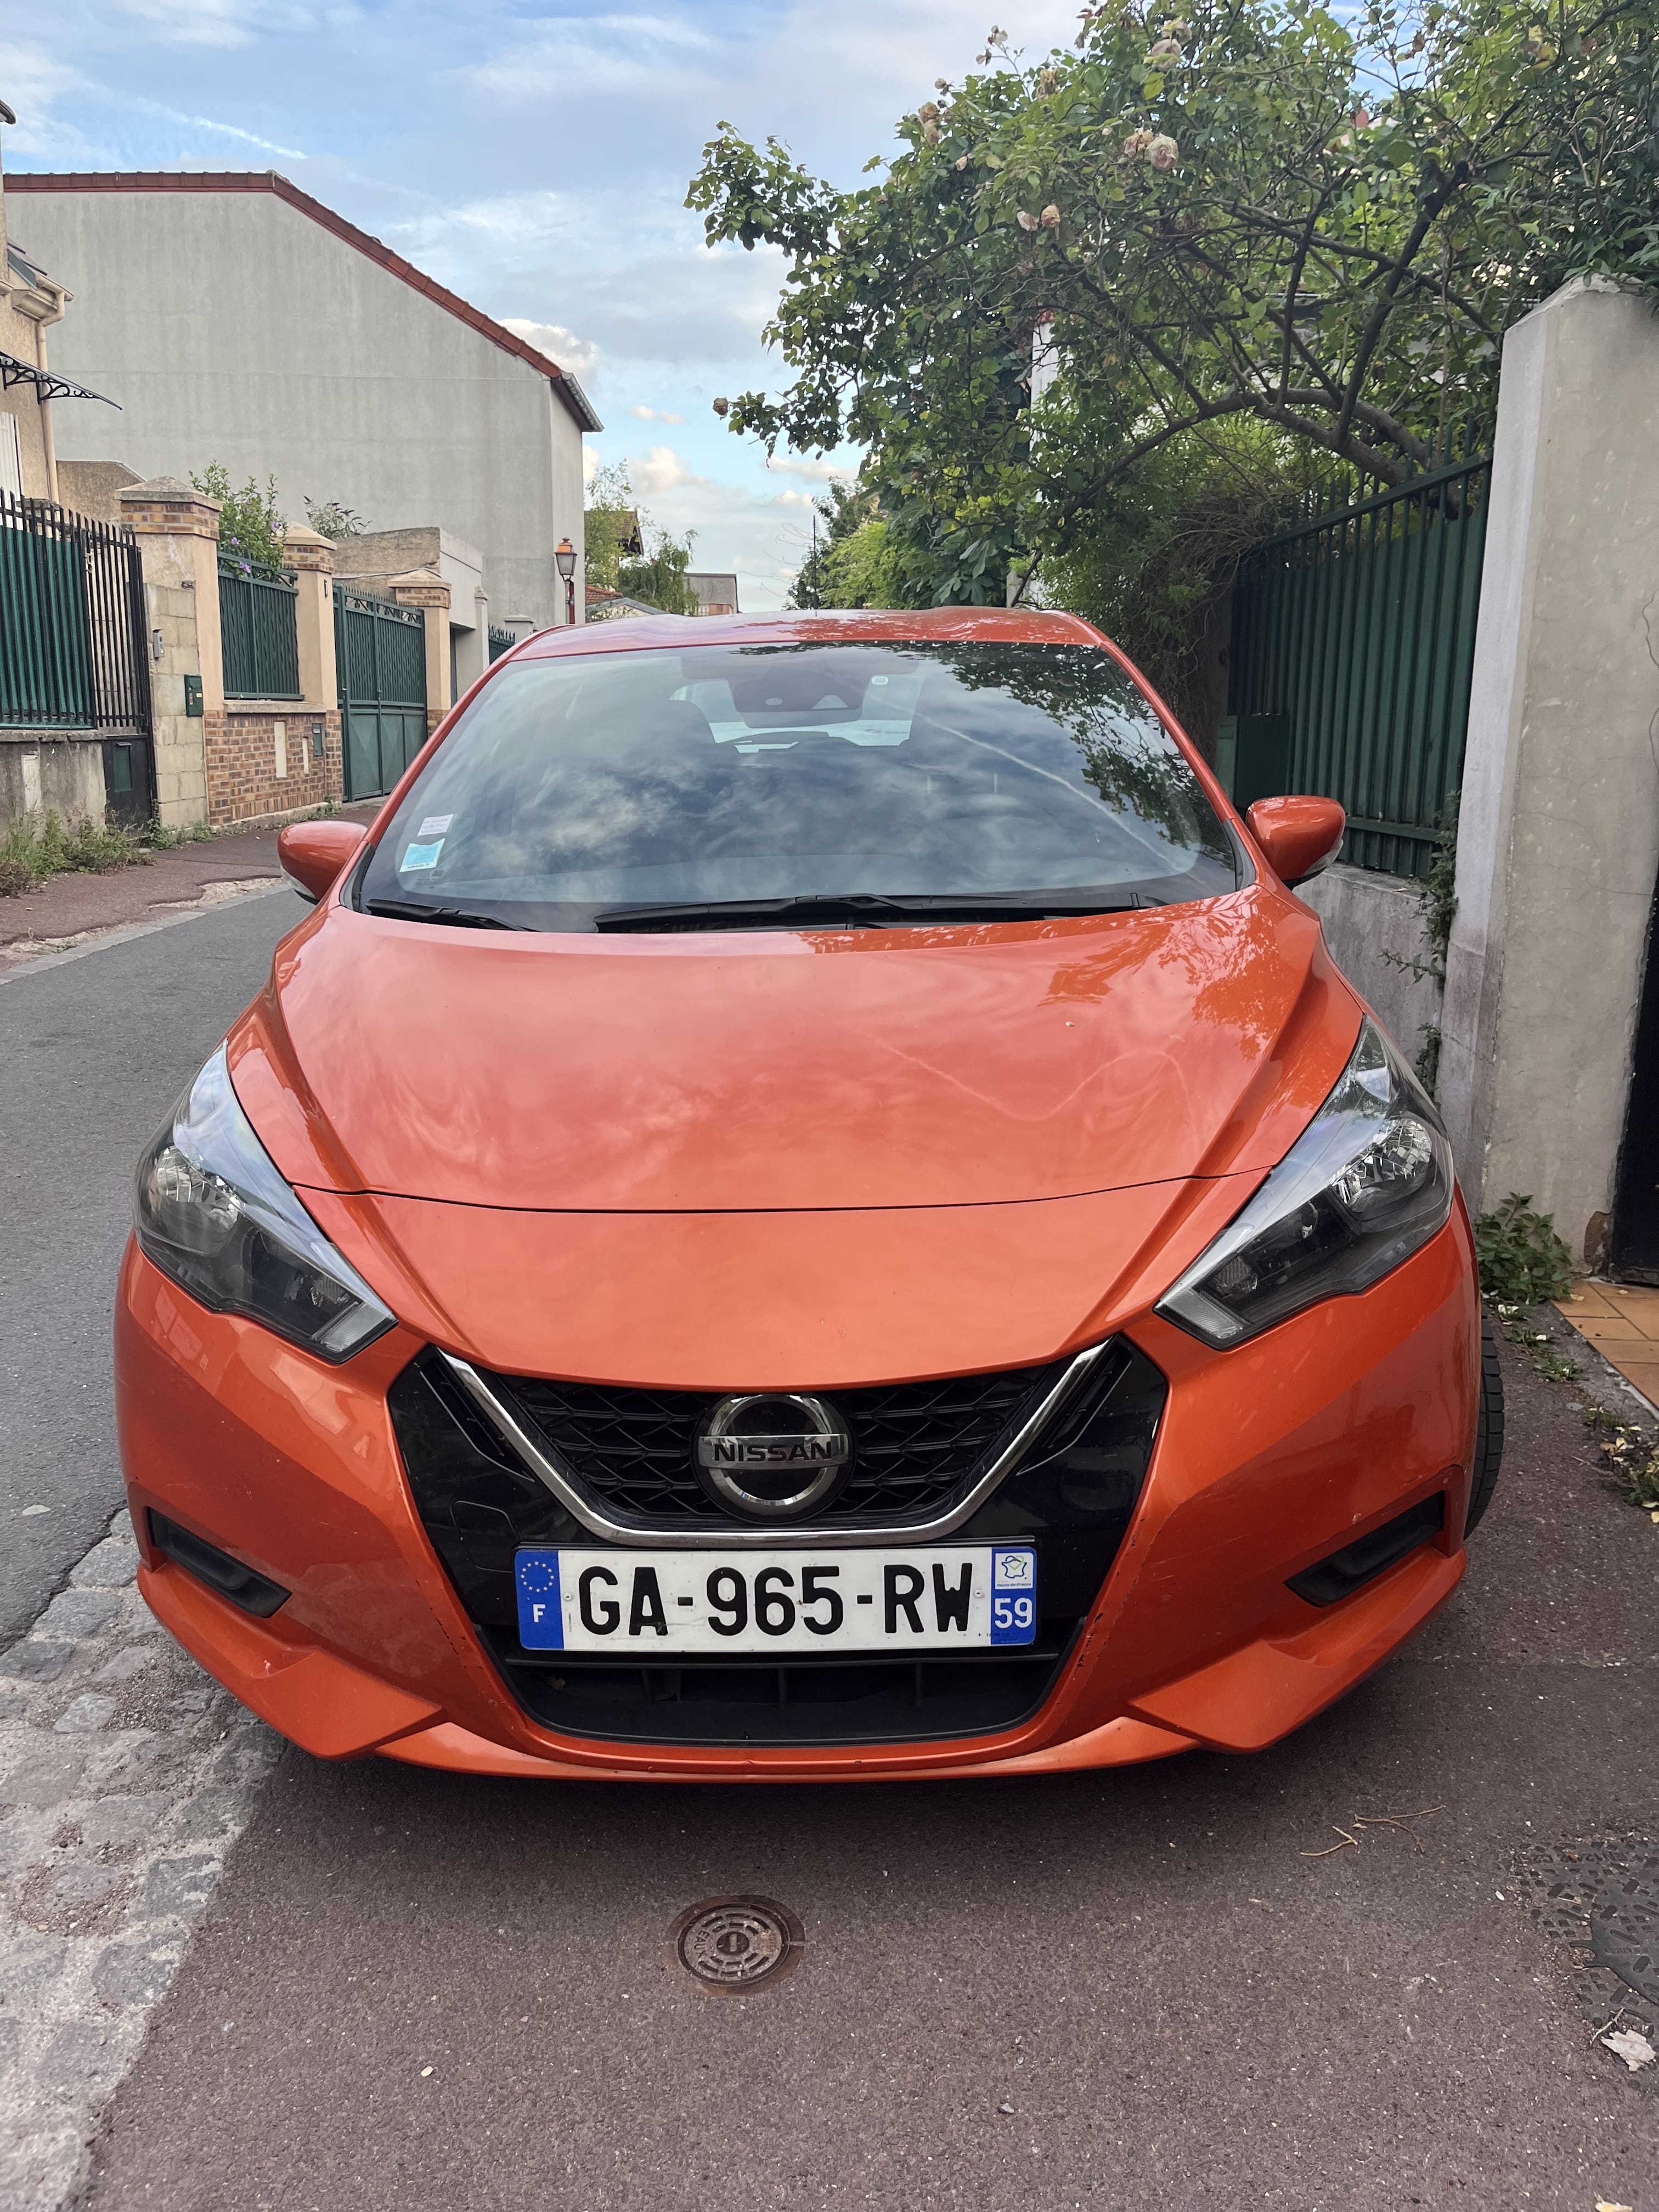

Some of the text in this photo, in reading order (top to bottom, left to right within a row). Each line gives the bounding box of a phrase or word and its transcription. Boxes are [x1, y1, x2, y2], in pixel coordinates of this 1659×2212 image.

[714, 1441, 832, 1462] NISSAN
[578, 1562, 973, 1635] GA-965-RW
[533, 1604, 545, 1622] F
[995, 1598, 1032, 1628] 59
